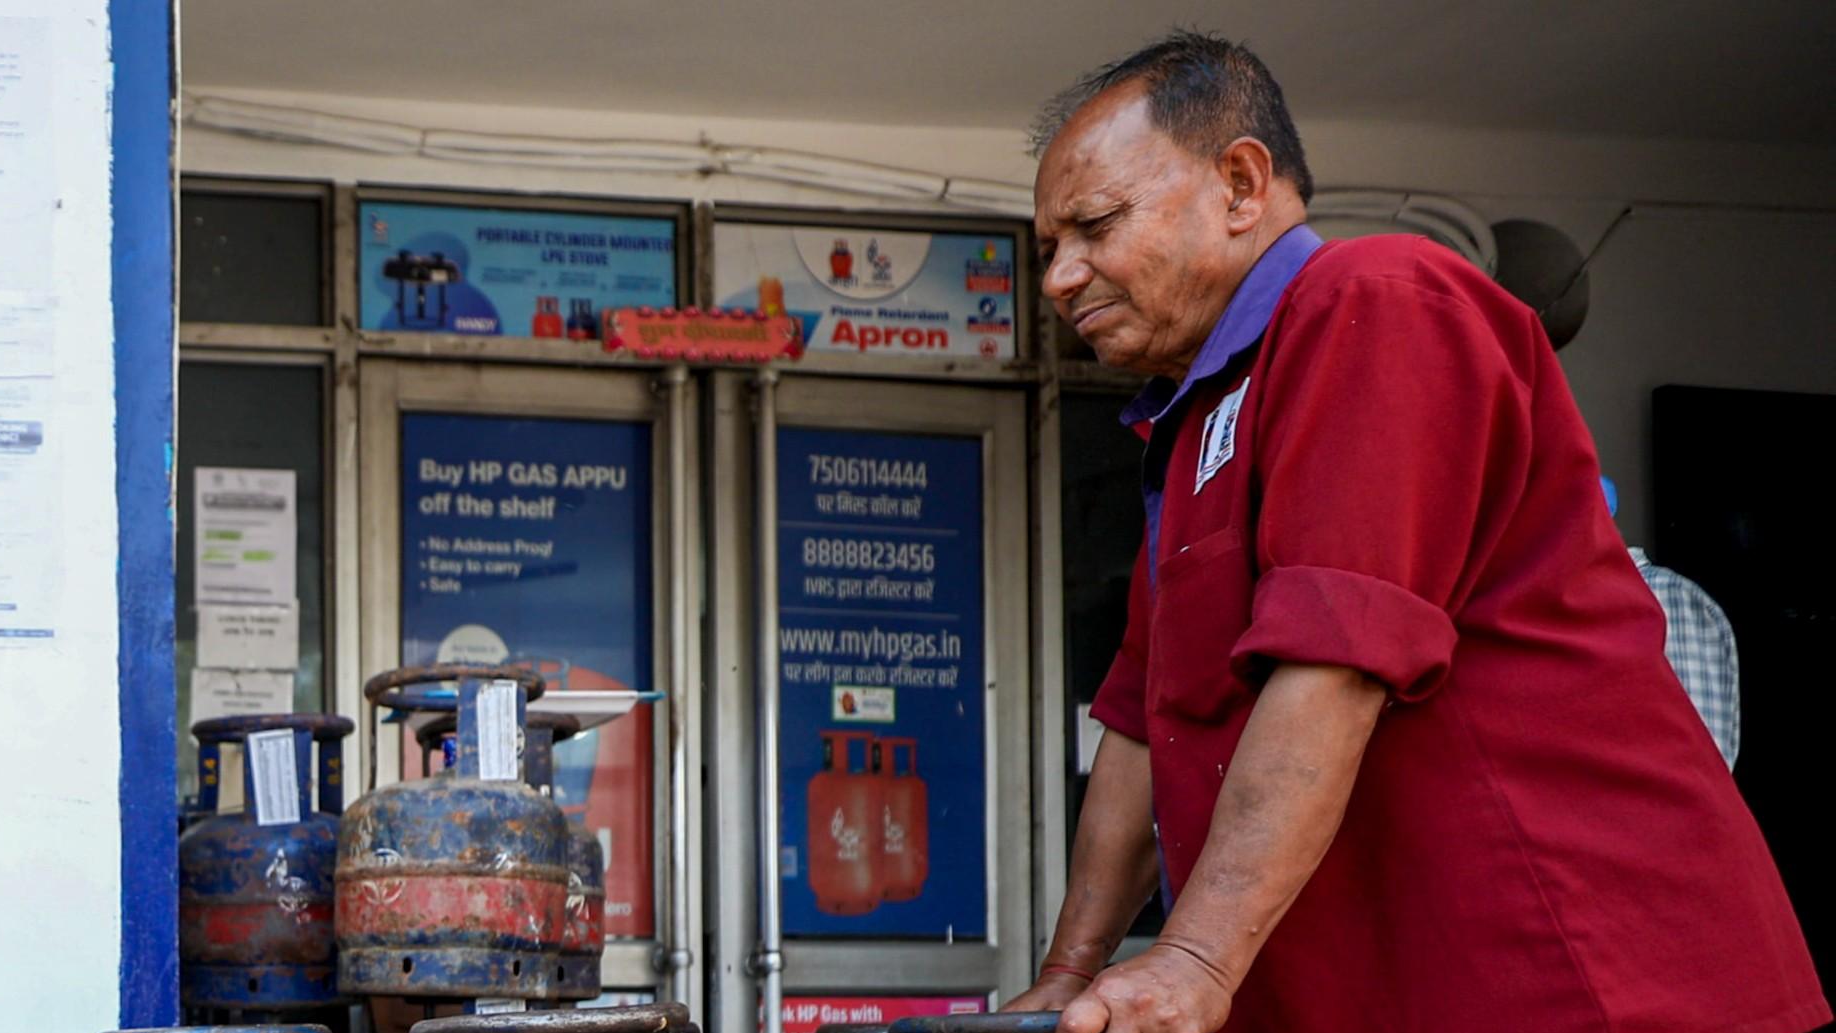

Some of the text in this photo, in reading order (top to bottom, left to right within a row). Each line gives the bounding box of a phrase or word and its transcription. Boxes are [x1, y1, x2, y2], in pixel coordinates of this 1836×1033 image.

[477, 226, 541, 245] PORTABLE
[544, 229, 606, 248] CYLINDER
[831, 319, 949, 352] Apron
[420, 459, 627, 489] Buy HP GAS APPU
[809, 455, 927, 488] 7506114444
[420, 493, 556, 518] off the shelf
[454, 538, 511, 554] Address
[803, 537, 935, 573] 8888823456
[428, 556, 522, 578] Easy to carry
[428, 576, 461, 593] Safe
[780, 625, 961, 663] www.myhpgas.in
[798, 1005, 817, 1023] HP
[820, 1004, 848, 1023] Gas
[850, 1004, 882, 1023] with
